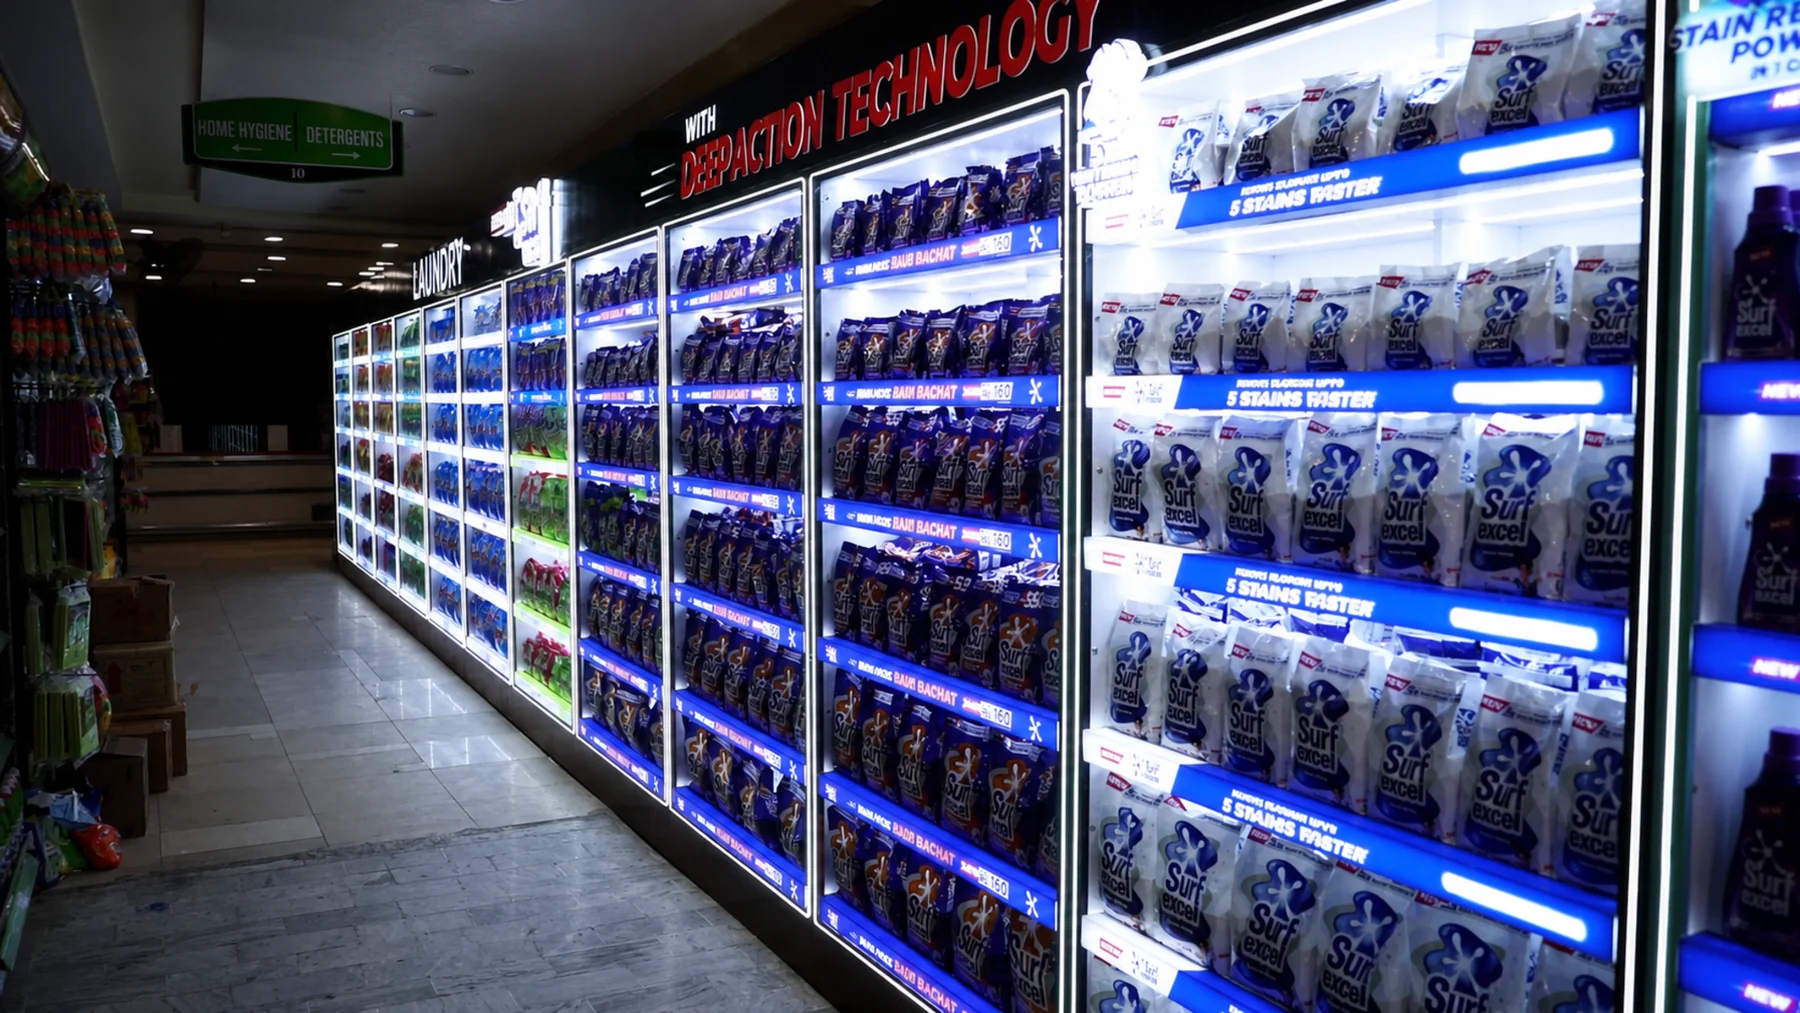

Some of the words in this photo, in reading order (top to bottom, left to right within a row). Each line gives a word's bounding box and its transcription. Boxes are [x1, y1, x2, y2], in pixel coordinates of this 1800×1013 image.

[1668, 10, 1757, 52] STAIN
[832, 0, 1100, 142] TECHNOLOGY
[1493, 83, 1536, 107] Surf
[685, 104, 717, 144] WITH
[1491, 105, 1529, 123] excel
[198, 119, 235, 138] HOME
[239, 120, 292, 142] HYGIENE
[306, 125, 384, 148] DETERGENTS
[291, 168, 305, 179] 10
[1229, 200, 1240, 216] 5
[1243, 185, 1307, 215] STAINS
[1310, 176, 1382, 205] FASTER
[413, 236, 464, 300] LAUNDRY
[915, 245, 957, 266] BACHAT
[1590, 308, 1634, 331] Surf
[1737, 299, 1776, 323] Surf
[1389, 318, 1419, 338] Surf
[1483, 317, 1516, 338] Surf
[1588, 329, 1628, 346] excel
[917, 385, 957, 400] BACHAT
[1227, 391, 1237, 407] 5
[1238, 391, 1303, 407] STAINS
[1305, 391, 1378, 409] FASTER
[1114, 470, 1143, 497] Surf
[1165, 479, 1197, 508] Surf
[1307, 482, 1348, 512] Surf
[1112, 492, 1140, 512] excel
[1229, 486, 1264, 516] Surf
[1384, 490, 1429, 522] Surf
[1481, 487, 1536, 520] Surf
[1165, 505, 1198, 525] excel
[1229, 514, 1263, 534] excel
[1304, 508, 1343, 529] excel
[917, 518, 957, 540] BACHAT
[1381, 519, 1424, 542] excel
[1477, 519, 1527, 542] excel
[1757, 567, 1798, 592] Surf
[1226, 578, 1236, 592] 5
[1238, 579, 1302, 604] STAINS
[1304, 590, 1375, 618] FASTER
[1114, 664, 1143, 692] Surf
[1753, 659, 1798, 679] NEW
[917, 680, 958, 706] BACHAT
[1113, 687, 1139, 707] excel
[1168, 680, 1198, 710] Surf
[1167, 706, 1197, 727] excel
[1231, 704, 1265, 736] Surf
[1229, 730, 1263, 754] excel
[1298, 712, 1339, 752] Surf
[1297, 746, 1336, 771] excel
[1383, 744, 1430, 780] Surf
[1381, 776, 1424, 803] excel
[1476, 769, 1528, 811] Surf
[1472, 801, 1521, 833] excel
[1222, 798, 1232, 814] 5
[1234, 802, 1296, 838] STAINS
[1298, 826, 1370, 866] FASTER
[916, 836, 956, 867] BACHAT
[1102, 841, 1134, 879] Surf
[1165, 861, 1207, 902] Surf
[1744, 858, 1795, 900] Surf
[1162, 892, 1199, 928] excel
[1249, 902, 1300, 946] Surf
[1243, 934, 1283, 971] excel
[917, 976, 959, 1013] BACHAT
[1321, 966, 1369, 1010] excel
